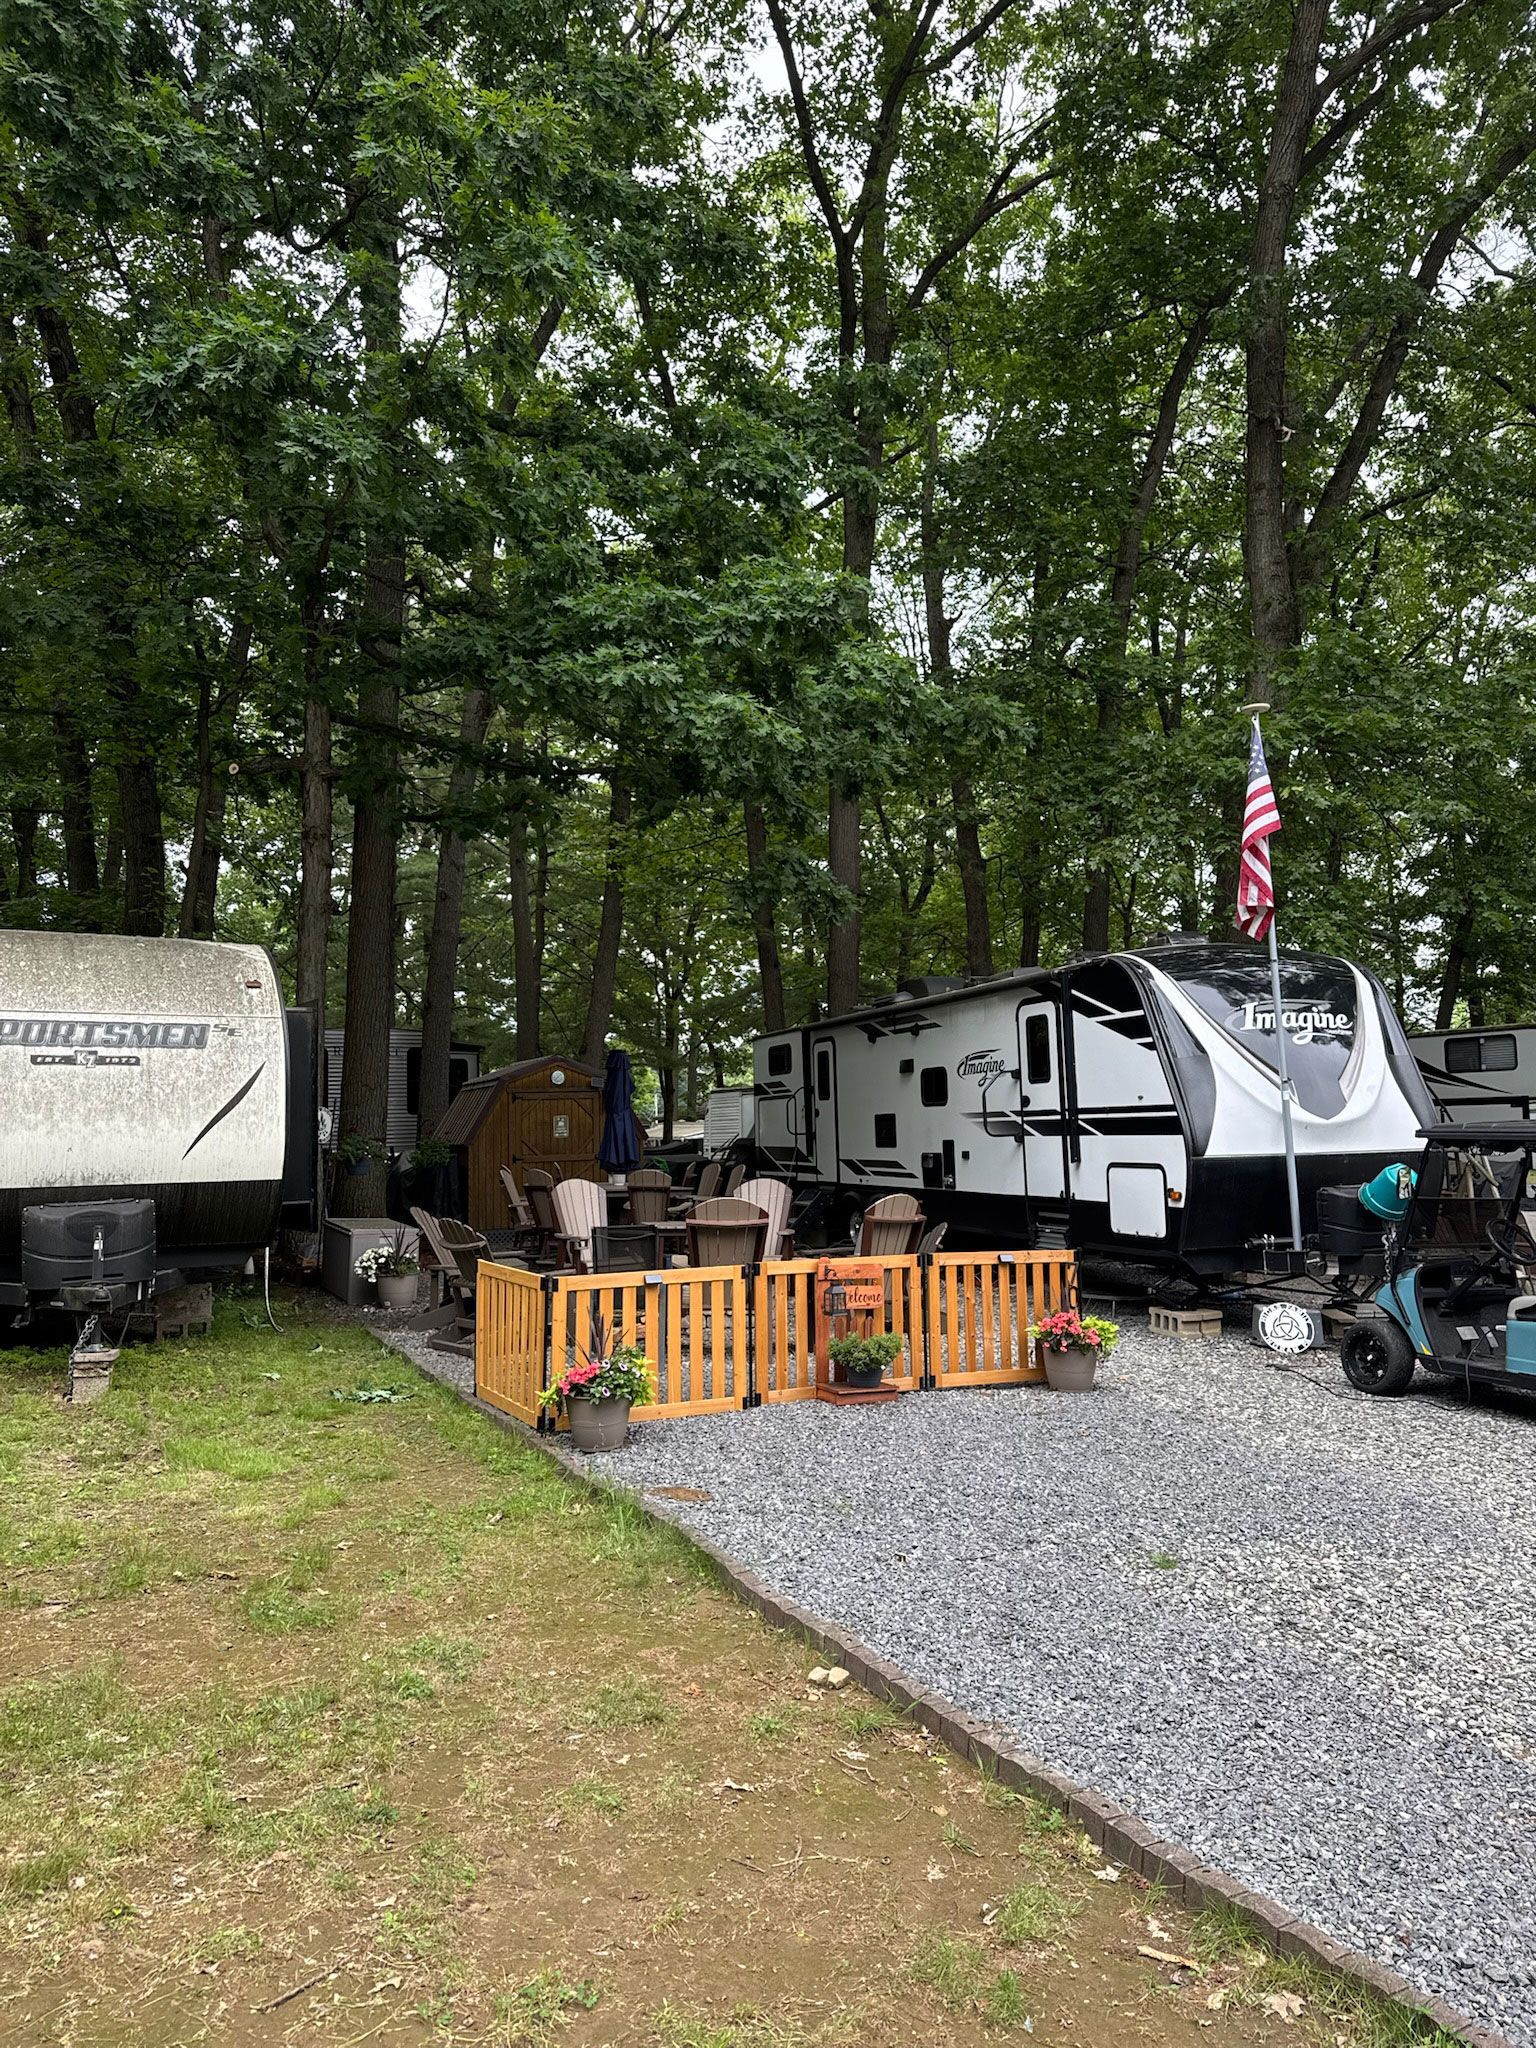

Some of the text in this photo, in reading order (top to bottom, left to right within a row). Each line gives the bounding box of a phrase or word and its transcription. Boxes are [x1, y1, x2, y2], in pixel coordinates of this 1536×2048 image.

[212, 1023, 242, 1037] SE
[1240, 1002, 1353, 1044] Imagine
[77, 1052, 95, 1068] KZ
[960, 1054, 1006, 1087] Imagine
[849, 1286, 882, 1303] elcome
